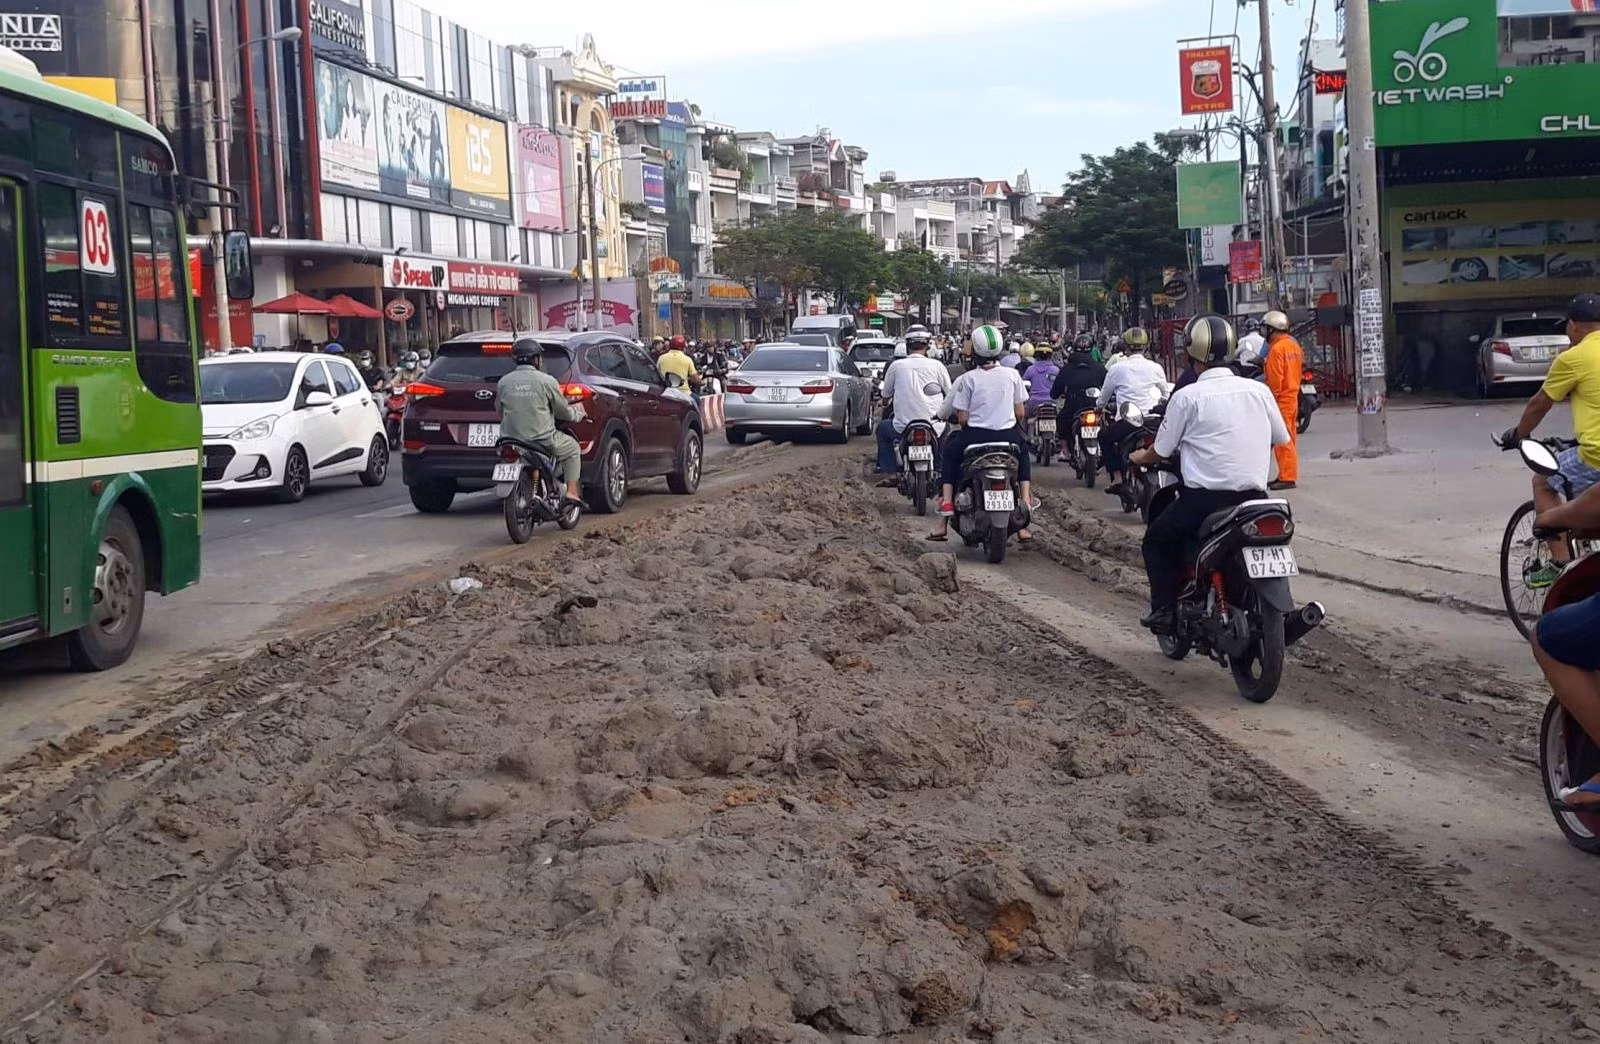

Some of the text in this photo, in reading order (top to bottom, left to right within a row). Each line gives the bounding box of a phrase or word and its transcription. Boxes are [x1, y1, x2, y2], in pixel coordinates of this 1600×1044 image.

[1372, 83, 1504, 105] IETWASH
[85, 207, 110, 267] 03
[447, 293, 500, 307] HIGHLANDS COFFEE
